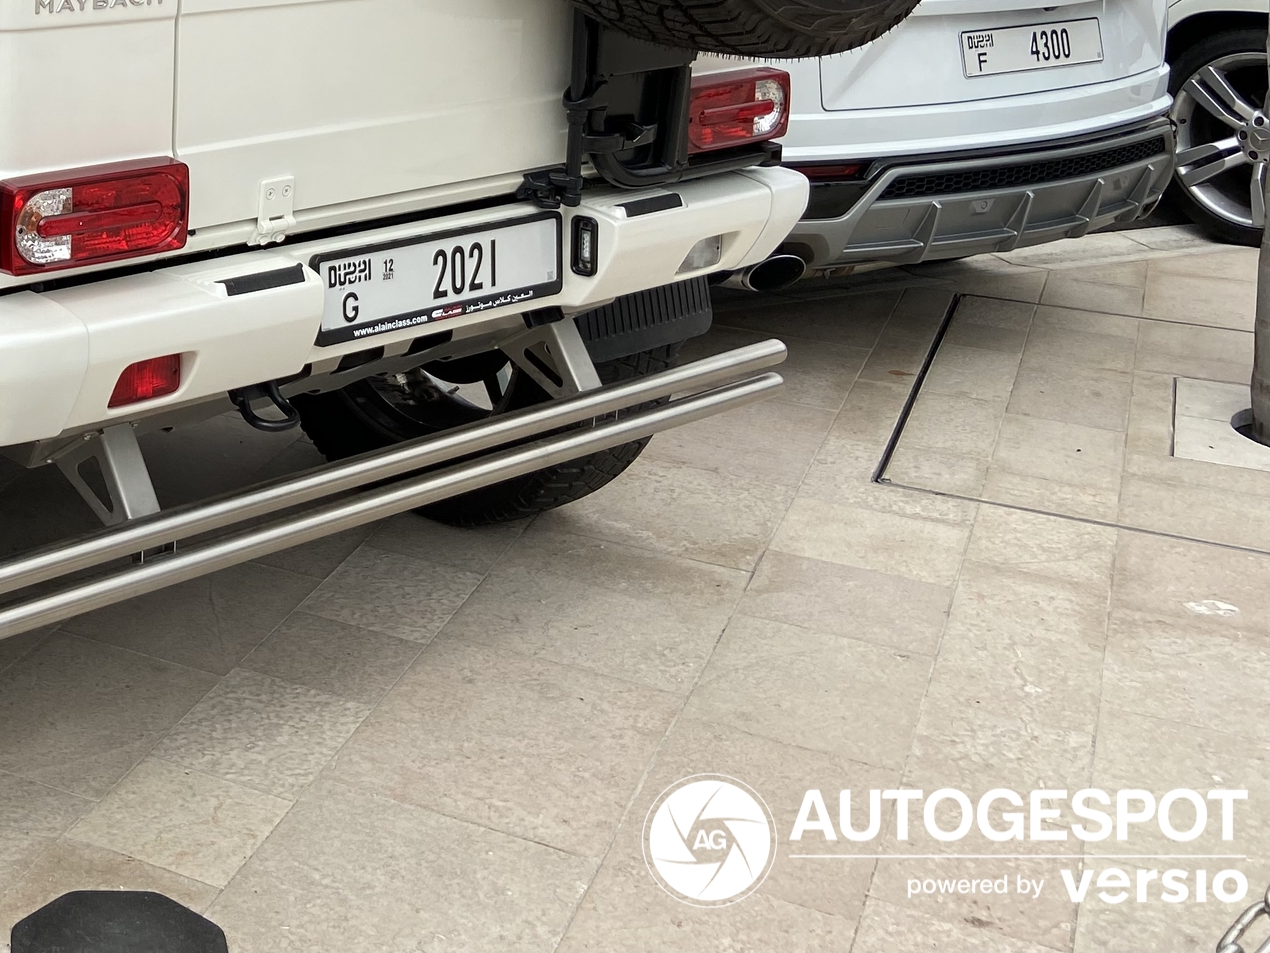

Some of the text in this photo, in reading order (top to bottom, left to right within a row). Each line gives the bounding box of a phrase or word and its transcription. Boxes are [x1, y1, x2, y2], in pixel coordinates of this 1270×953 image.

[1030, 28, 1071, 62] 4300
[977, 52, 988, 72] F
[382, 272, 394, 281] 2021
[383, 258, 394, 272] 12
[432, 239, 497, 300] 2021
[342, 291, 359, 323] G
[352, 314, 428, 338] www.alainclass.com
